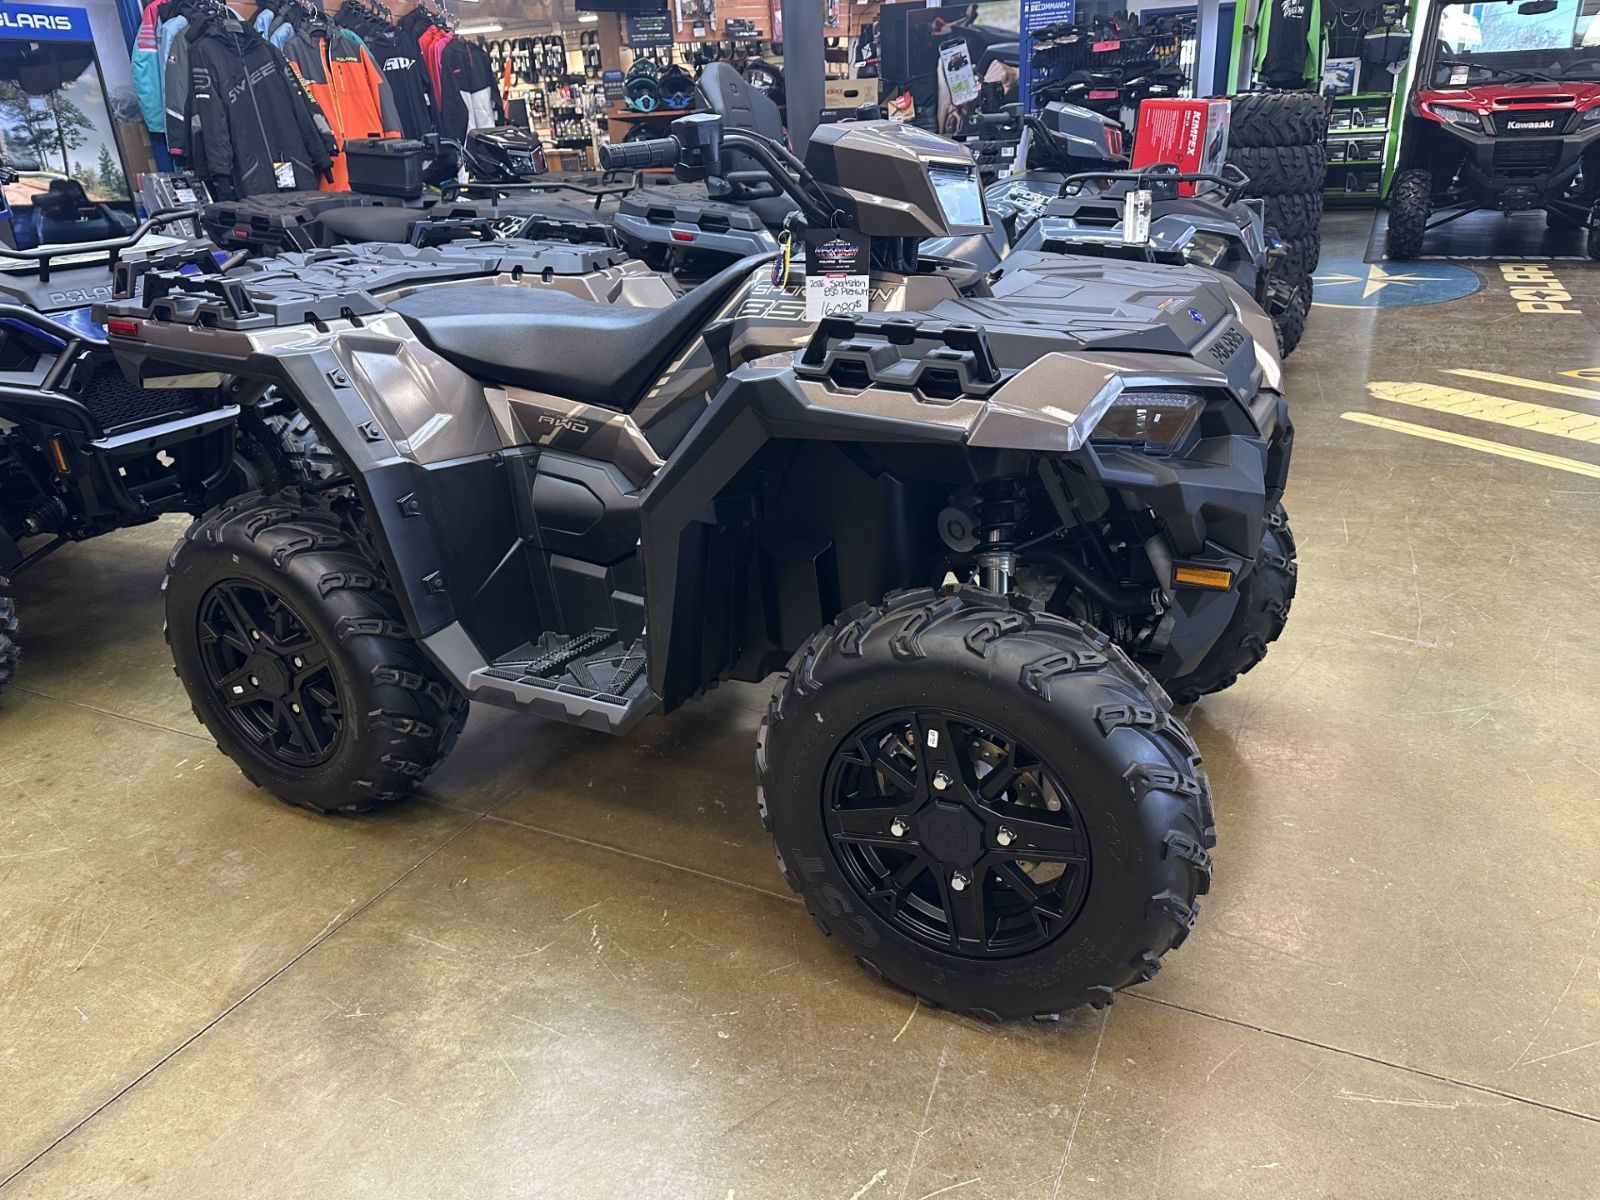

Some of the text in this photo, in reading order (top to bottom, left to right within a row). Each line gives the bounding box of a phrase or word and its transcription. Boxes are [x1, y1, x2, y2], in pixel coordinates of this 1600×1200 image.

[0, 12, 72, 30] LARIS
[1186, 110, 1202, 156] KIMPEX
[1507, 120, 1555, 129] Kawasaki
[1498, 262, 1583, 314] POLARI
[735, 299, 806, 320] 85
[538, 415, 589, 434] AWD
